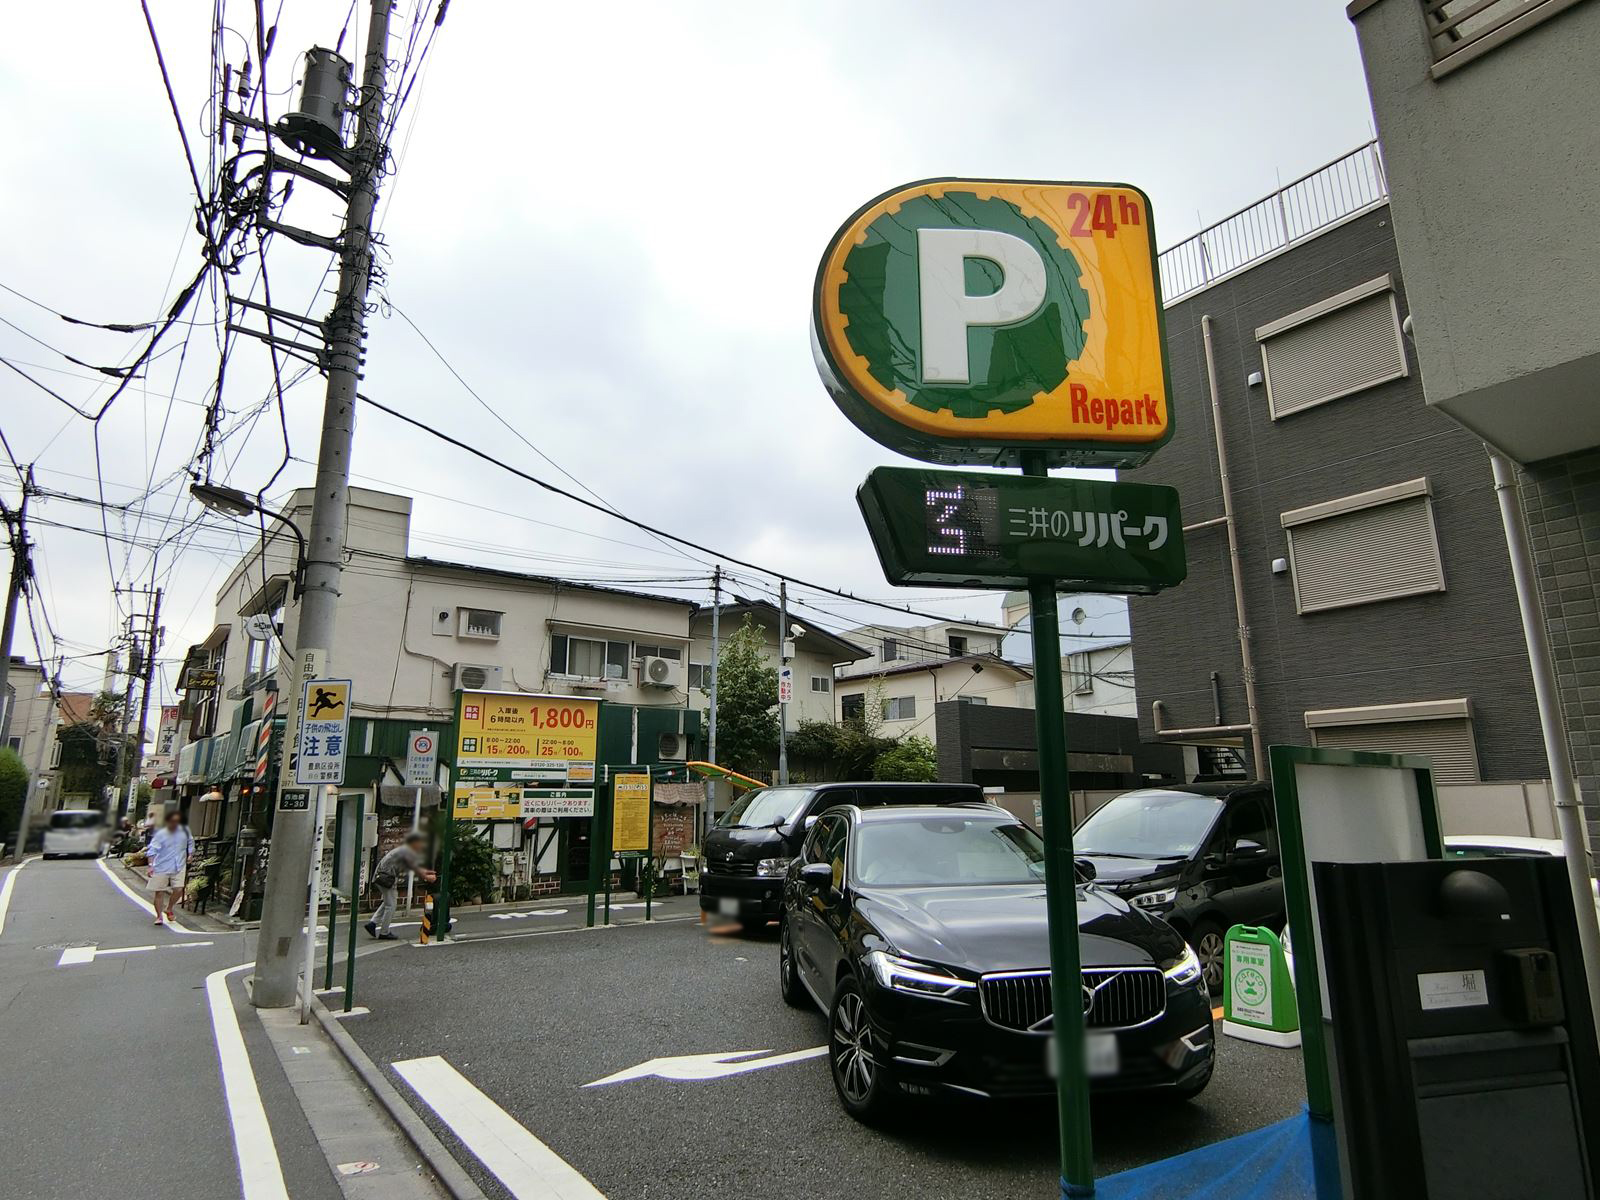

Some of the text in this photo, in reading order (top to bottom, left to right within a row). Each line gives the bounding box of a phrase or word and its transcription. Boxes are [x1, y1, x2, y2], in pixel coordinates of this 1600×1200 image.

[1066, 192, 1141, 239] 24h
[916, 227, 1048, 385] P
[1068, 382, 1163, 431] Repark
[1008, 506, 1168, 551] 三井のリパーク
[304, 723, 344, 734] 子供の飛出し
[490, 714, 525, 724] 6時間以内
[530, 706, 594, 729] 1,800円
[303, 735, 342, 757] 注意
[284, 800, 305, 808] 2-30
